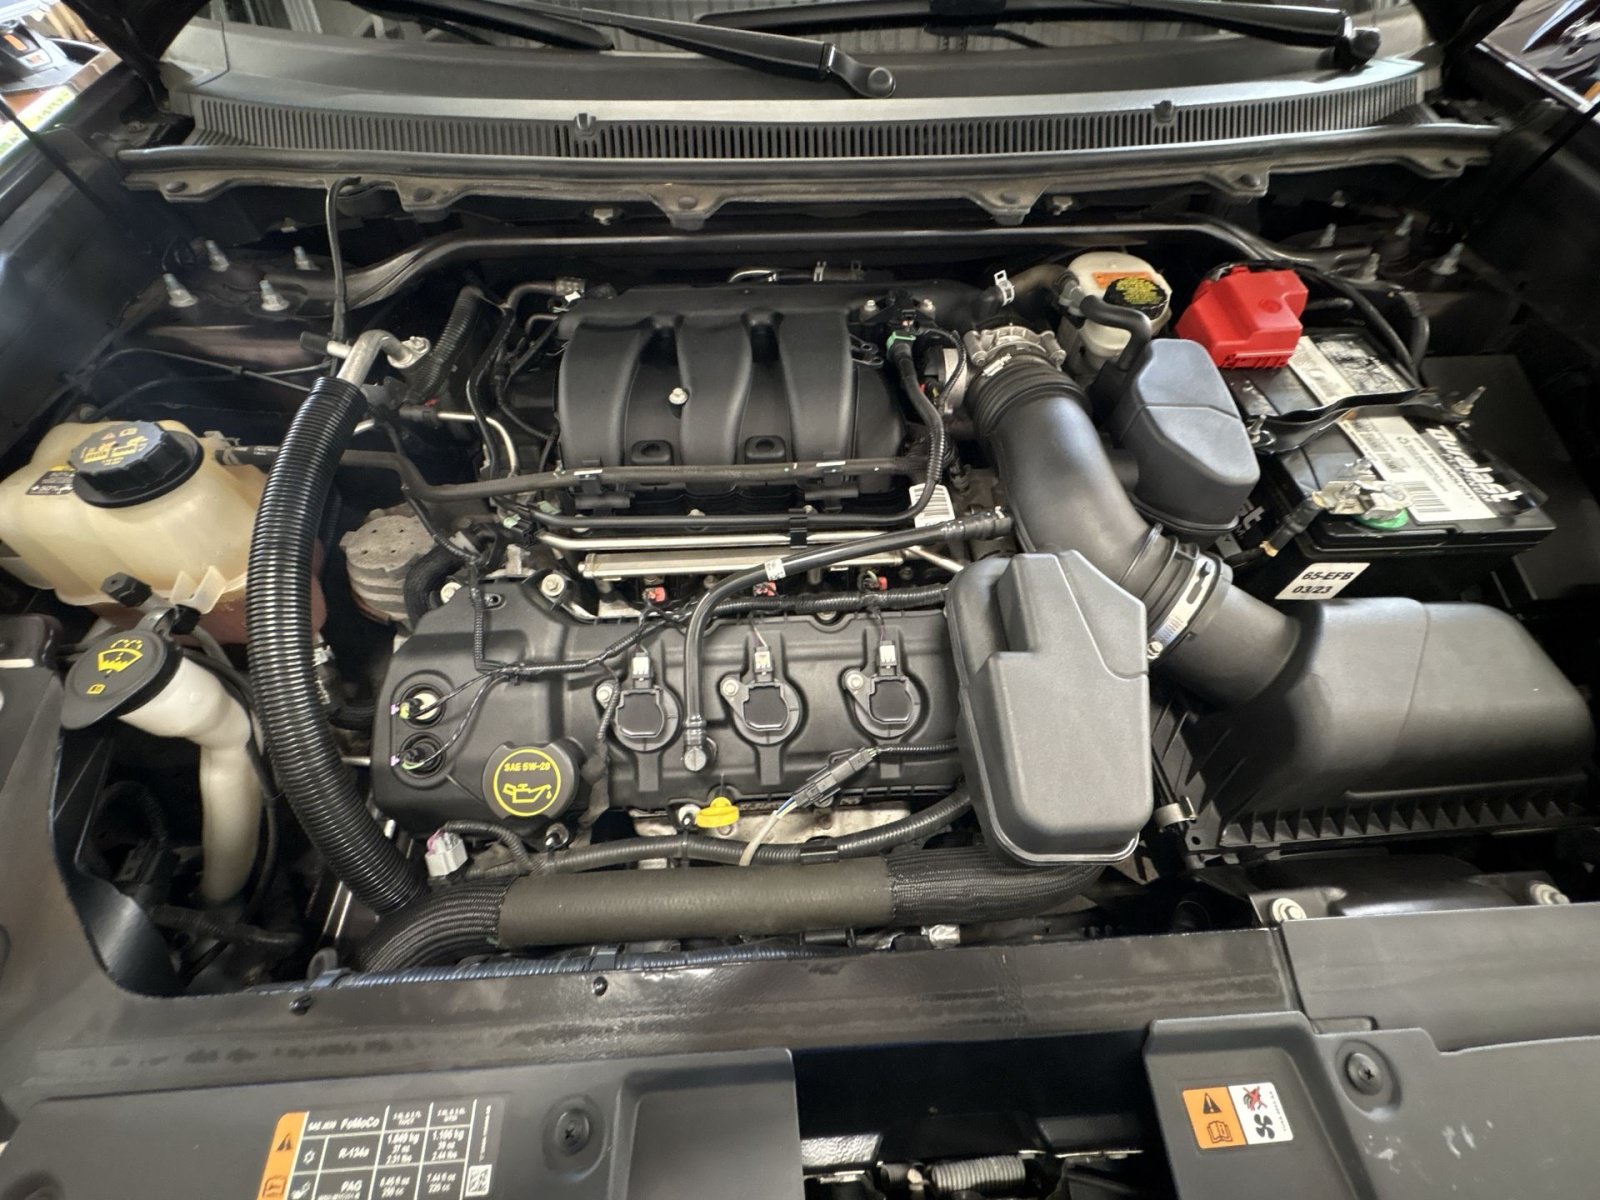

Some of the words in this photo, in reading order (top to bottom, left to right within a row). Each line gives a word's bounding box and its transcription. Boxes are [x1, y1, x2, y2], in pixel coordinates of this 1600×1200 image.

[1425, 425, 1522, 502] Duralast
[1302, 572, 1355, 580] 65-EFB
[1292, 585, 1333, 594] 03/23
[504, 762, 521, 772] SAE
[522, 762, 551, 771] 5W-20
[341, 1179, 363, 1193] PAG
